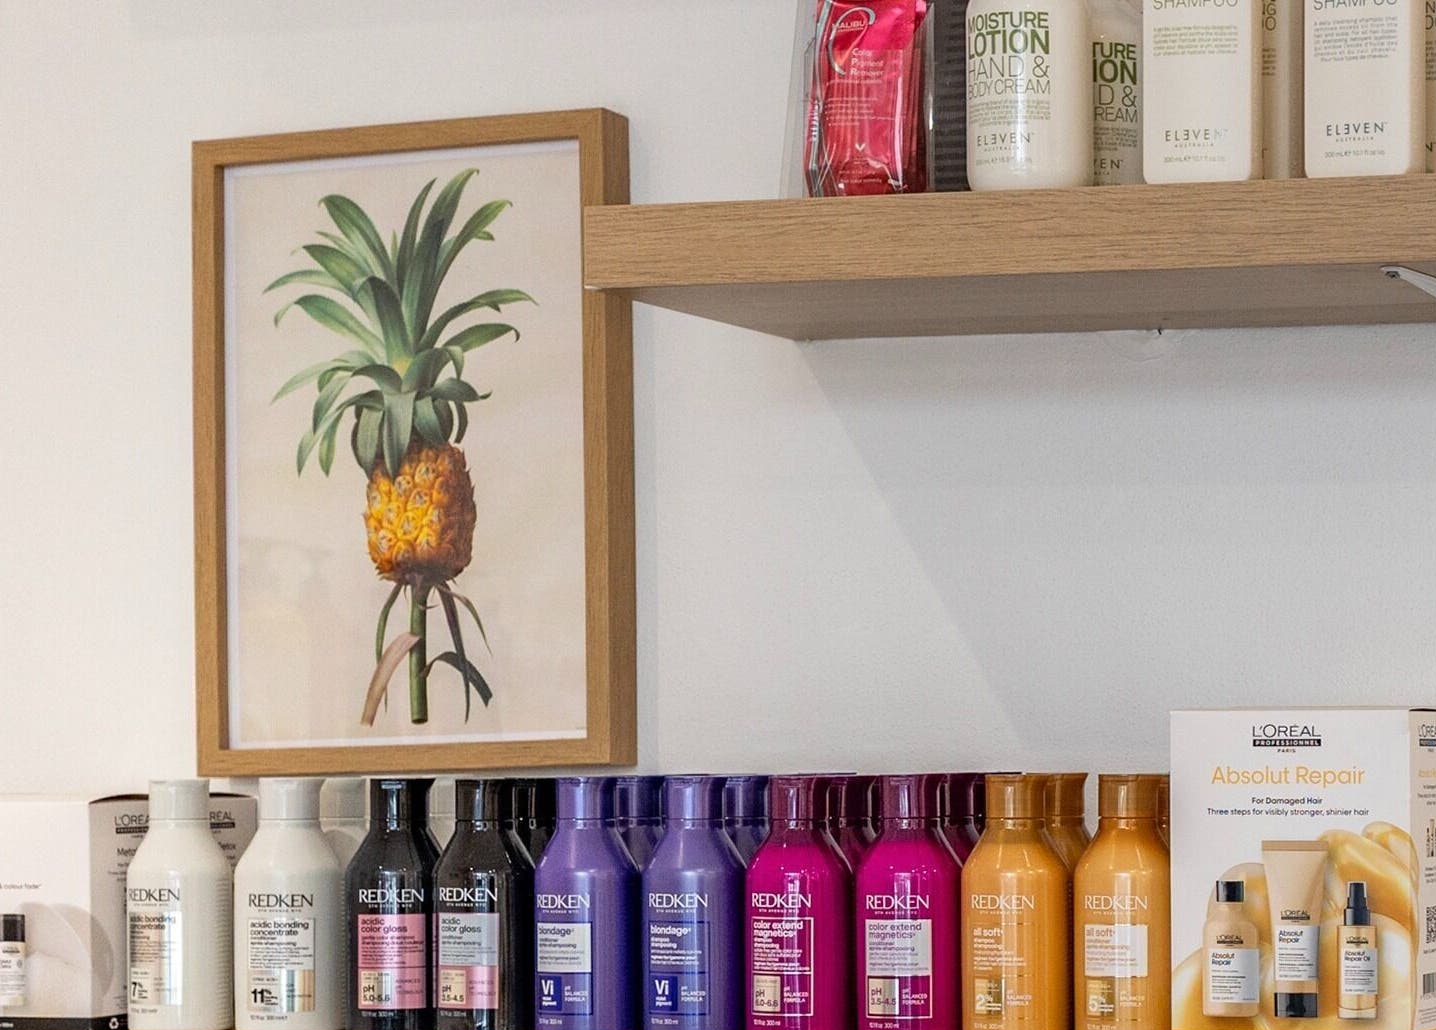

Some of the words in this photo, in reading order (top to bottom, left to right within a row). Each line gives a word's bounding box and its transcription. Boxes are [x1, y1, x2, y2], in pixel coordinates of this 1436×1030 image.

[968, 11, 1050, 32] MOISTURE
[968, 30, 1050, 59] LOTION
[1093, 42, 1137, 61] TURE
[852, 58, 884, 69] Pigment
[968, 56, 1024, 80] HAND
[1033, 55, 1050, 78] &
[852, 68, 884, 77] Remover
[1093, 60, 1137, 87] ION
[968, 82, 995, 101] BODY
[997, 79, 1051, 96] CREAM
[1094, 106, 1138, 124] REAM
[1165, 128, 1223, 142] ELEVEN
[1326, 122, 1385, 137] ELEVEN
[977, 132, 1031, 148] ELEVEN
[1211, 765, 1290, 785] Absolut
[1295, 765, 1365, 788] Repair
[1265, 797, 1305, 807] Damaged
[1230, 808, 1251, 817] steps
[1264, 808, 1288, 817] visibly
[1290, 808, 1325, 817] stronger,
[128, 888, 181, 902] REDKEN
[248, 894, 314, 908] REDKEN
[359, 889, 424, 904] REDKEN
[439, 888, 499, 902] REDKEN
[537, 894, 590, 909] REDKEN
[649, 893, 708, 909] REDKEN
[752, 893, 812, 909] REDKEN
[866, 895, 930, 910] REDKEN
[971, 895, 1034, 910] REDKEN
[1084, 895, 1148, 910] REDKEN
[250, 921, 272, 929] acidic
[274, 920, 310, 930] bonding
[441, 917, 460, 925] acidic
[754, 921, 771, 929] color
[772, 920, 803, 929] extend
[869, 923, 888, 931] color
[890, 923, 922, 931] extend
[250, 929, 299, 937] concentrate
[361, 925, 382, 933] color
[383, 926, 408, 935] gloss
[441, 925, 458, 933] color
[459, 925, 482, 934] gloss
[539, 927, 571, 937] blondage
[650, 925, 687, 937] blondage
[1279, 929, 1303, 937] Absolut
[1278, 936, 1300, 944] Repair
[1211, 958, 1232, 966] Repair
[363, 985, 375, 994] pH
[541, 979, 554, 995] Vi
[655, 979, 669, 995] Vi
